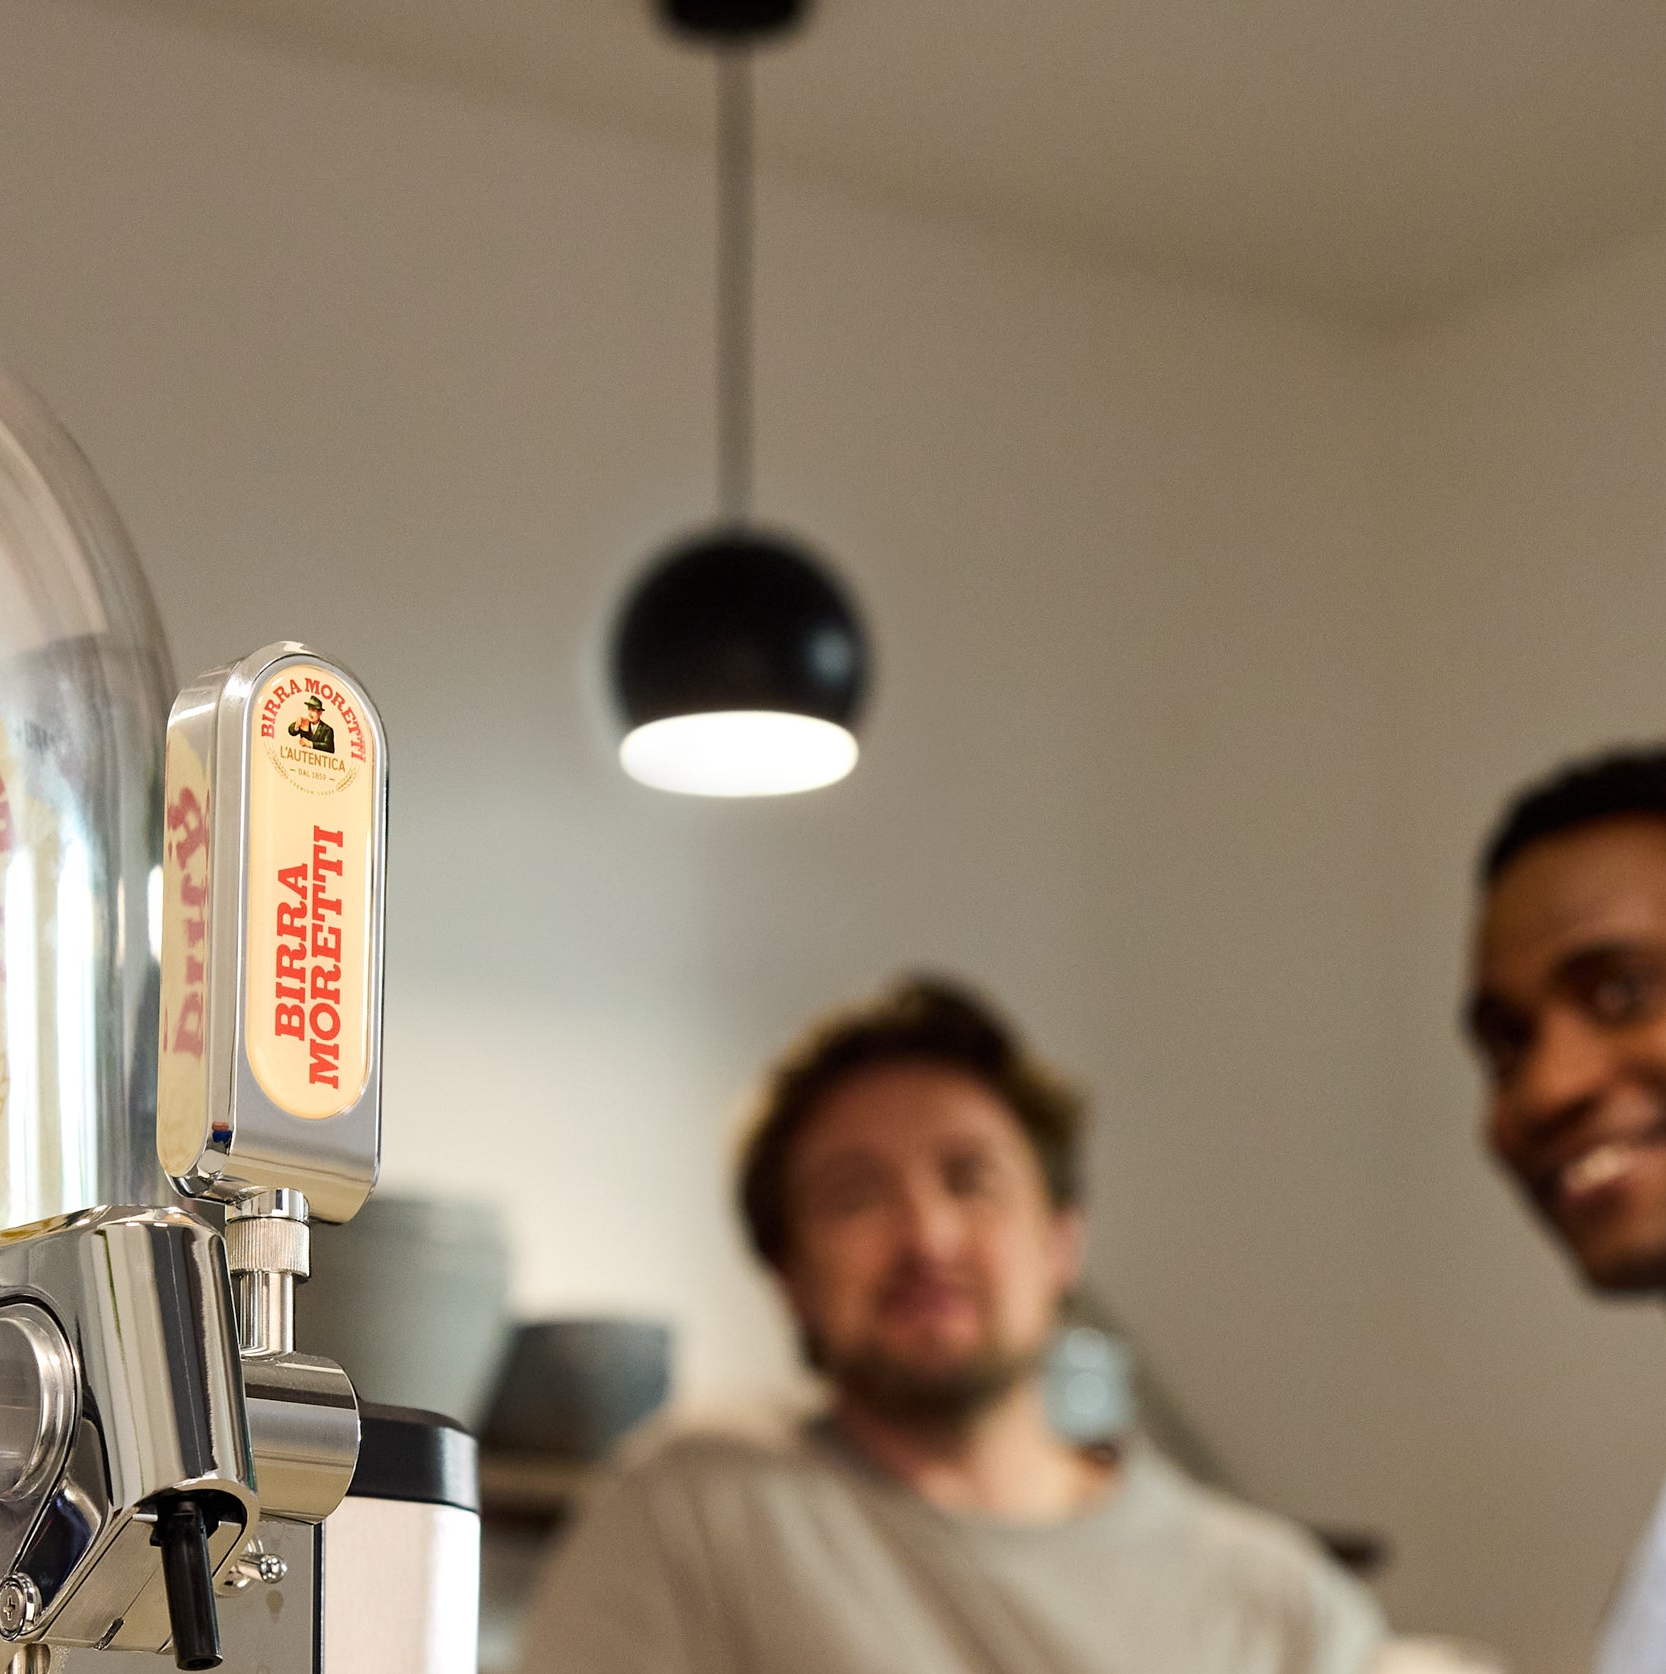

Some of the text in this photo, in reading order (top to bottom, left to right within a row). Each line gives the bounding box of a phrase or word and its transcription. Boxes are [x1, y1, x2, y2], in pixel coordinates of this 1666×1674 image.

[261, 677, 366, 763] BIRRA MORETTI
[280, 745, 346, 772] L'AUTENTICA
[275, 863, 308, 1041] BIRRA
[309, 825, 343, 1090] MORETTI
